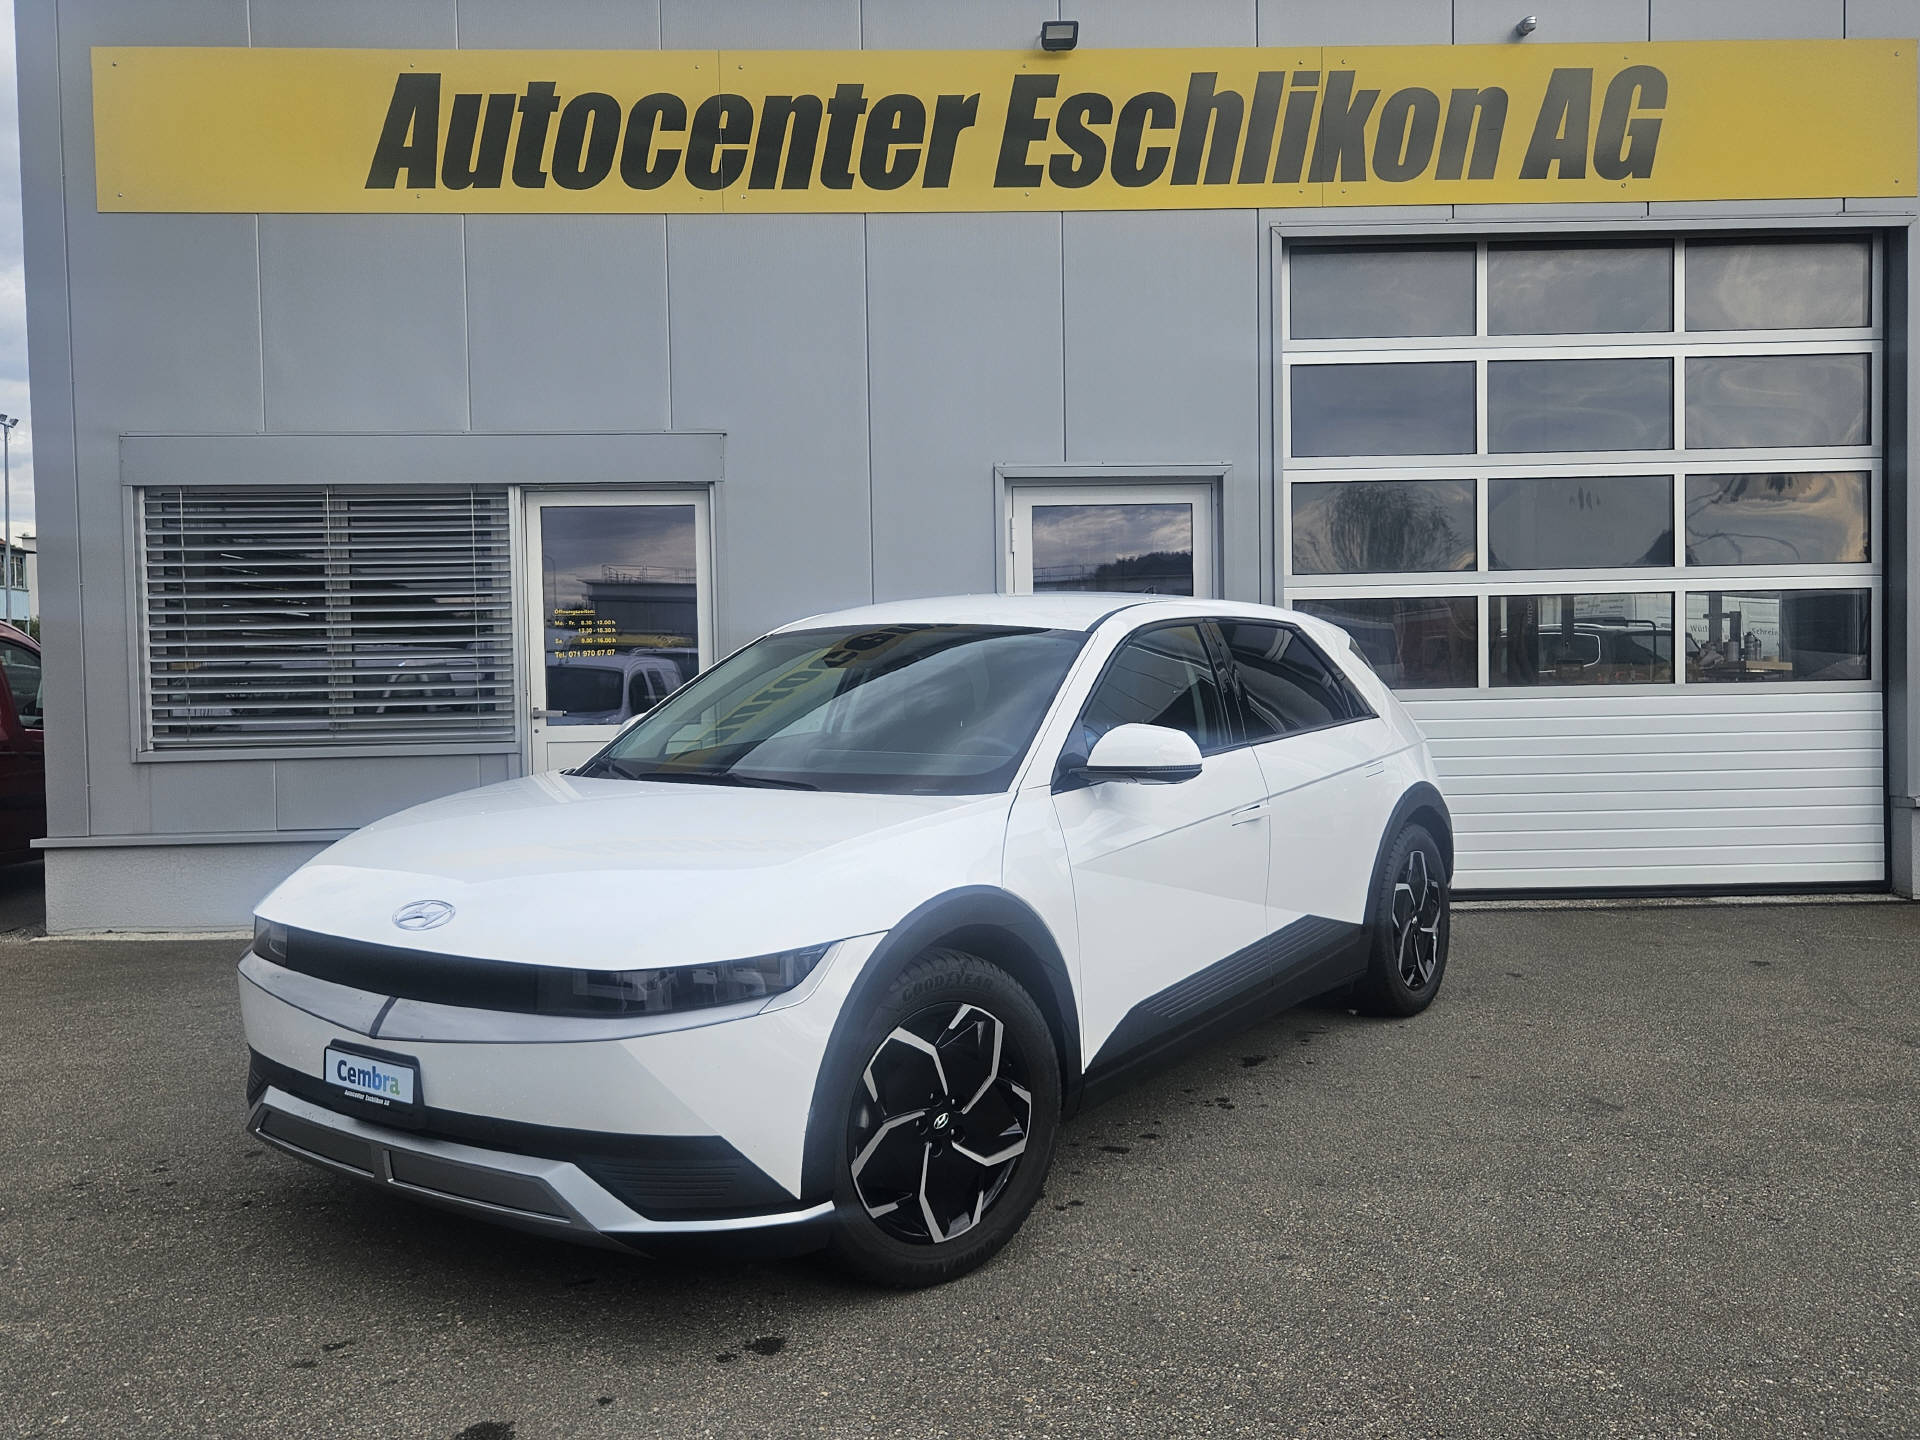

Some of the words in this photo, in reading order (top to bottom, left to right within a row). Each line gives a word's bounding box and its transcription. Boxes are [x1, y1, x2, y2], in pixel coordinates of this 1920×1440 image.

[365, 73, 980, 191] Autocenter
[994, 70, 1509, 189] Eschlikon
[1519, 65, 1668, 181] AG
[555, 651, 567, 659] Tel.
[606, 648, 616, 656] 07
[902, 972, 994, 1001] GOODYEAR
[337, 1059, 400, 1095] Cembra
